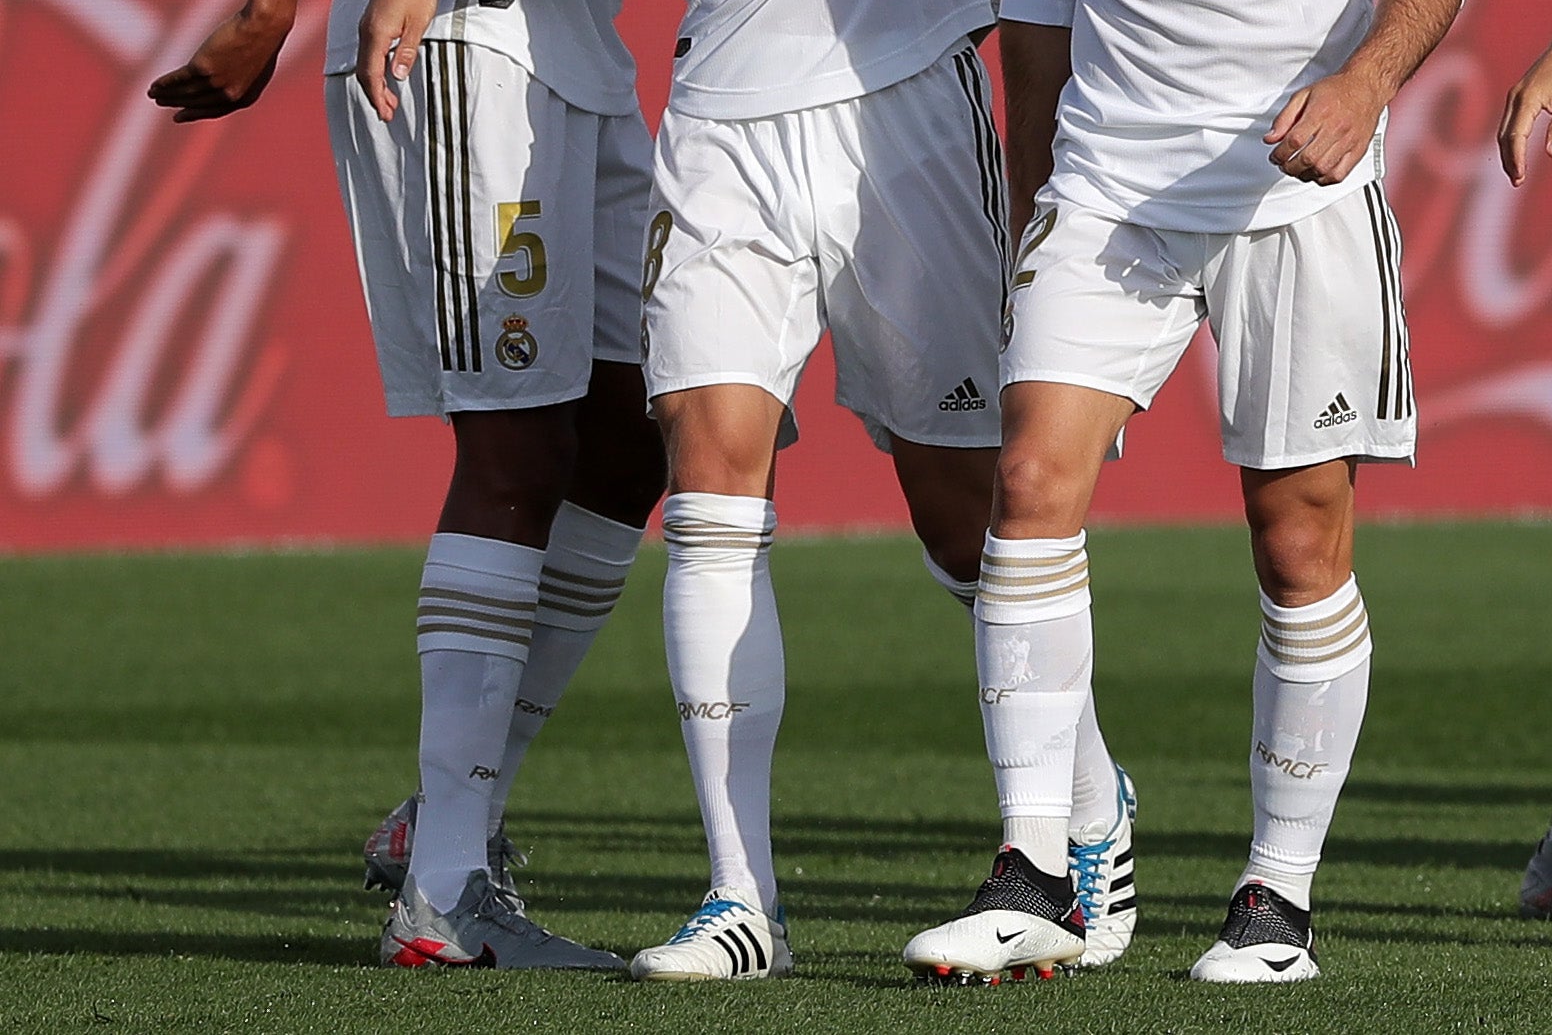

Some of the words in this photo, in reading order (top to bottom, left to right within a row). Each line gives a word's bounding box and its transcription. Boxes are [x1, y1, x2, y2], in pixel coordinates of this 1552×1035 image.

[493, 200, 548, 299] 5
[642, 209, 674, 305] 8
[938, 397, 987, 412] adidas
[1313, 410, 1358, 429] adidas
[678, 702, 750, 721] RMCF
[1256, 740, 1329, 780] RMCF
